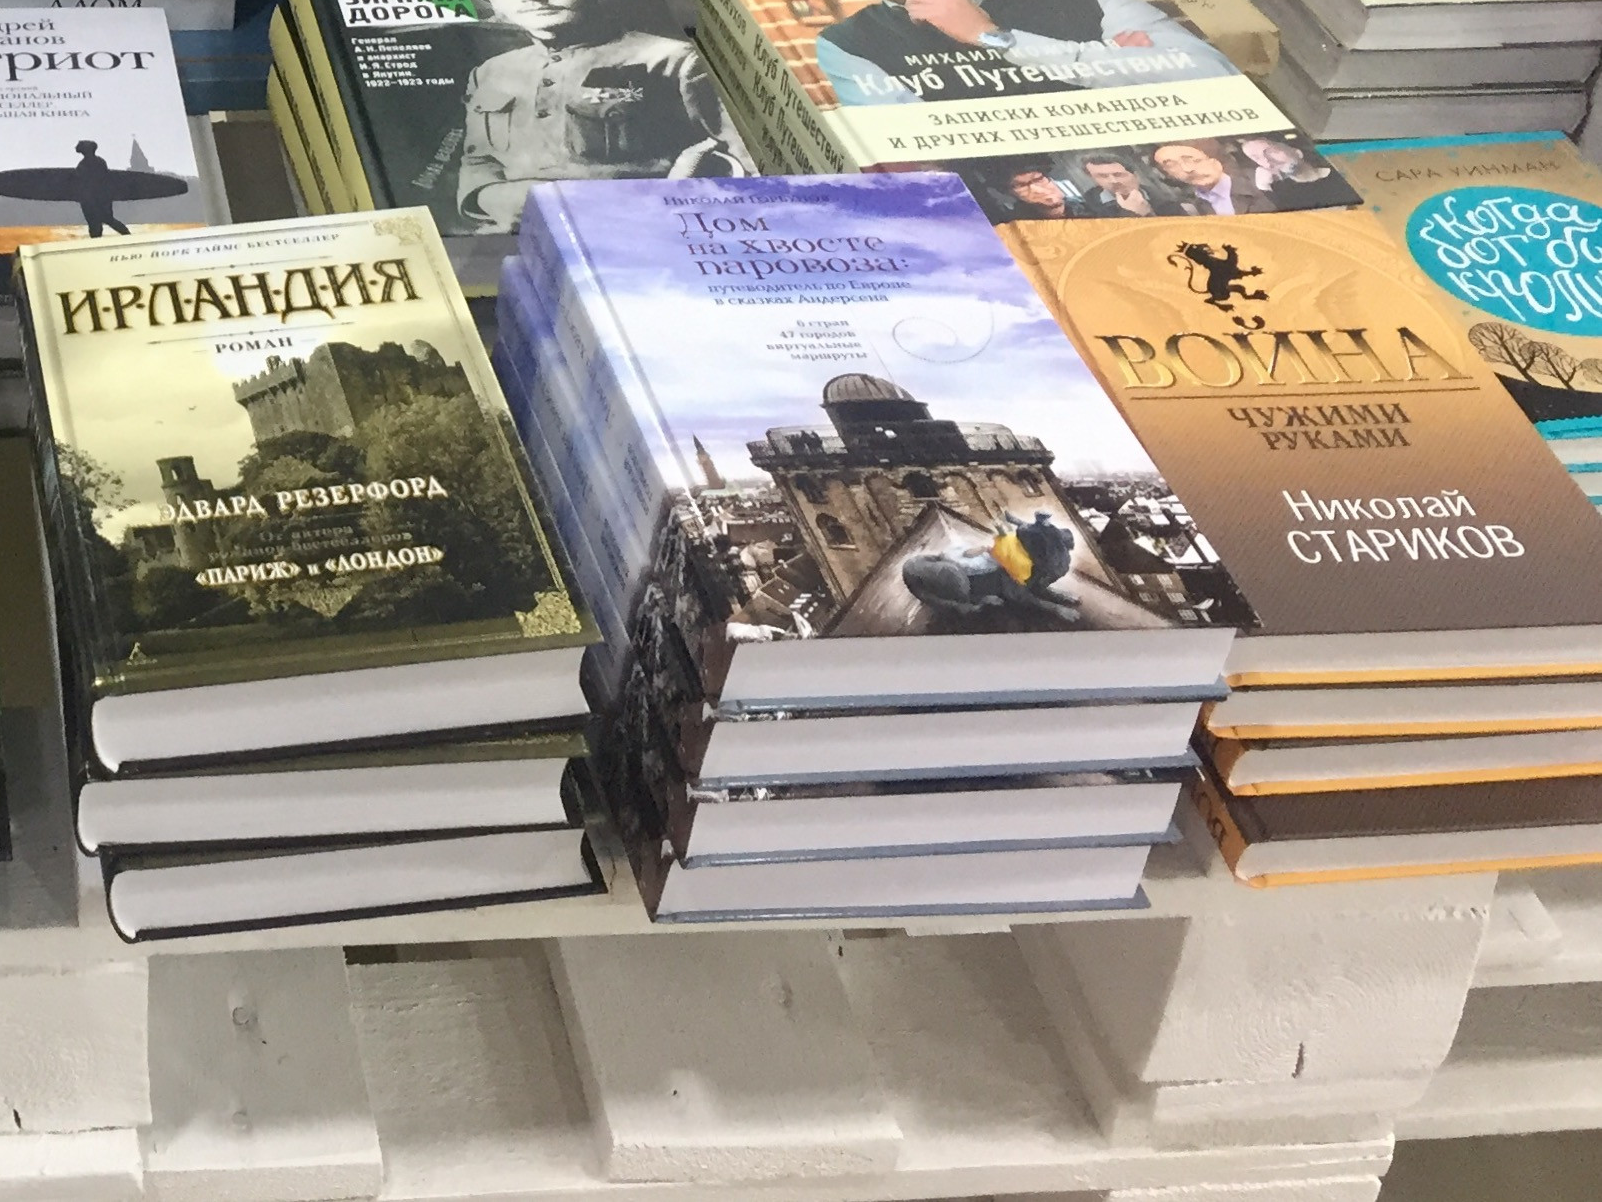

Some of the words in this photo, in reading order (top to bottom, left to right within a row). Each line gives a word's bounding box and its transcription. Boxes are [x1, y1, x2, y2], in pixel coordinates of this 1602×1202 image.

[349, 3, 473, 24] ДОРОГА
[351, 37, 397, 45] Генерал
[367, 53, 416, 61] анархист
[904, 49, 1000, 68] МИХАИЛ
[853, 65, 945, 97] Клуб
[956, 48, 1194, 91] Путешествий
[40, 109, 90, 117] КНИГА
[929, 106, 1037, 126] ЗАПИСКИ
[1045, 94, 1187, 117] КОМАНДОРА
[889, 136, 905, 150] И
[913, 129, 1007, 150] ДРУГИХ
[1012, 107, 1260, 142] ПУТЕШЕСТВЕННИКОВ
[1376, 168, 1443, 181] САРА
[674, 212, 770, 238] Дом
[1432, 196, 1602, 239] Когда
[194, 241, 243, 256] ТАЙМС
[687, 243, 728, 255] на
[738, 237, 887, 254] хвосте
[695, 257, 909, 279] паровоза:
[708, 283, 823, 294] путеводитель
[849, 280, 911, 292] Европе
[728, 295, 793, 305] сказках
[798, 294, 889, 305] Андерсена
[809, 320, 849, 328] стран
[799, 330, 856, 340] городов
[214, 337, 294, 354] РОМАН
[766, 341, 862, 351] виртуальные
[1094, 316, 1474, 389] ВОЙНА
[791, 351, 868, 362] маршруты
[1227, 403, 1412, 429] ЧУЖИМИ
[1260, 428, 1411, 452] РУКАМИ
[159, 496, 266, 523] ЭДВАРД
[276, 475, 447, 512] РЕЗЕРФОРД
[1283, 489, 1477, 521] Николай
[1287, 524, 1526, 564] СТАРИКОВ
[195, 561, 301, 586] «ПАРИЖ»
[325, 545, 444, 572] «ЛОНДОН»
